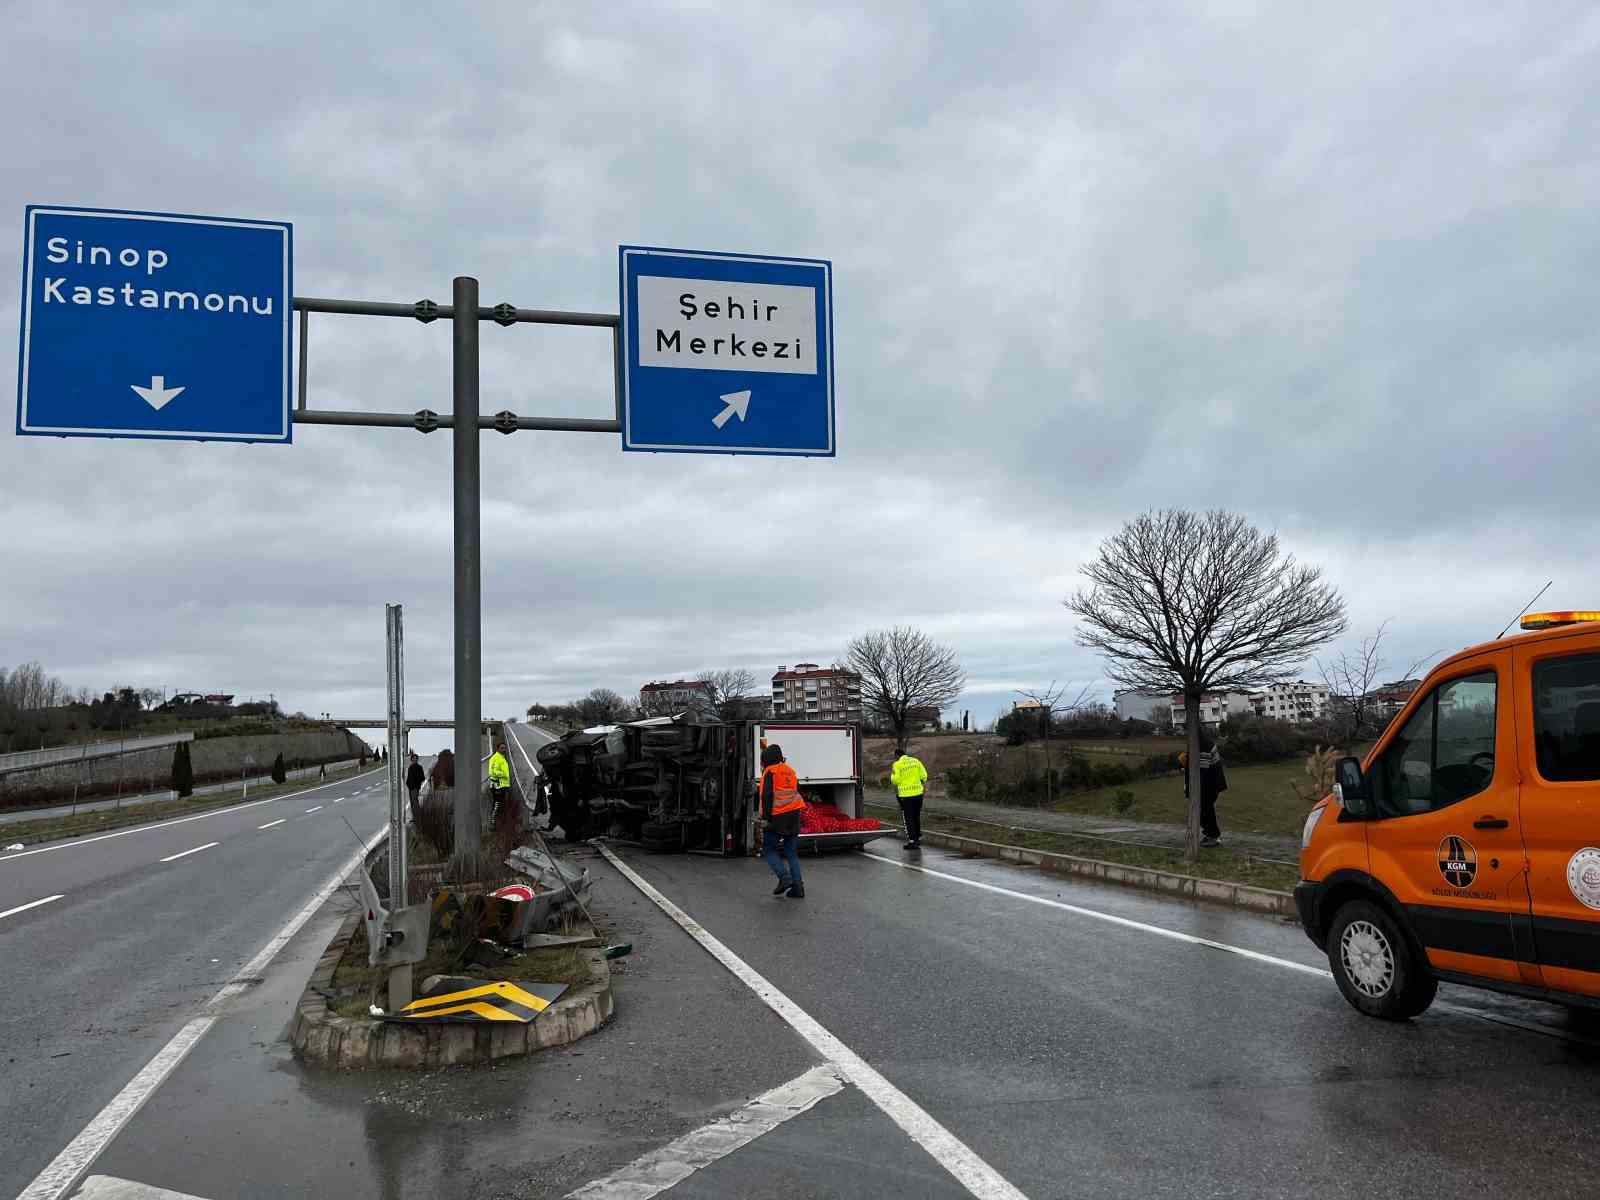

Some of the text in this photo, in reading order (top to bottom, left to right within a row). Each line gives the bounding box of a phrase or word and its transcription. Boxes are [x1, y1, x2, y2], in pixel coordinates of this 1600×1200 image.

[47, 237, 169, 275] Sinop
[43, 277, 274, 316] Kastamonu
[679, 293, 778, 321] Şehir
[656, 328, 801, 360] Merkezi
[1447, 862, 1467, 871] KGM
